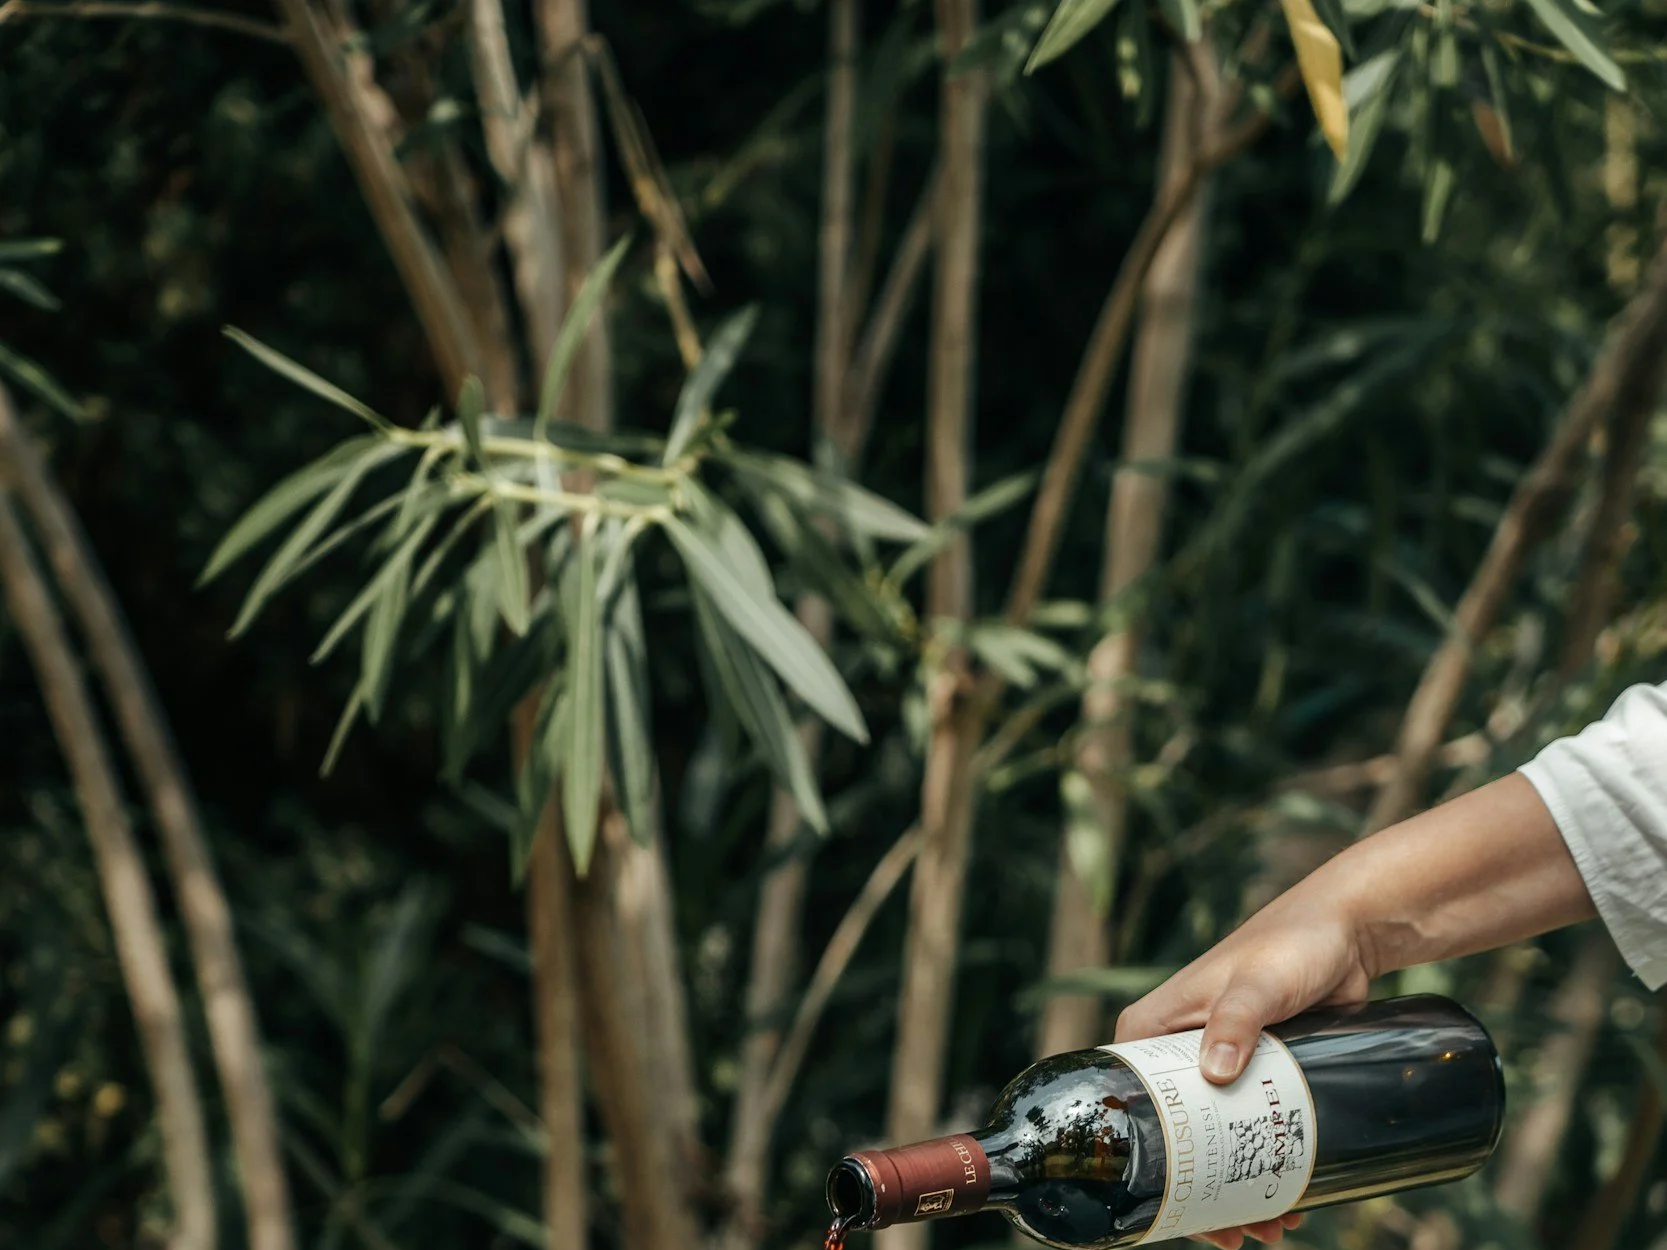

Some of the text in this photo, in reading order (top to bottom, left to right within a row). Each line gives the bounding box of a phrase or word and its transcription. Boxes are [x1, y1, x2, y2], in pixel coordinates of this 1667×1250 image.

[1156, 1078, 1196, 1202] CHIUSURE
[964, 1164, 977, 1185] LE
[1159, 1206, 1187, 1232] LE
